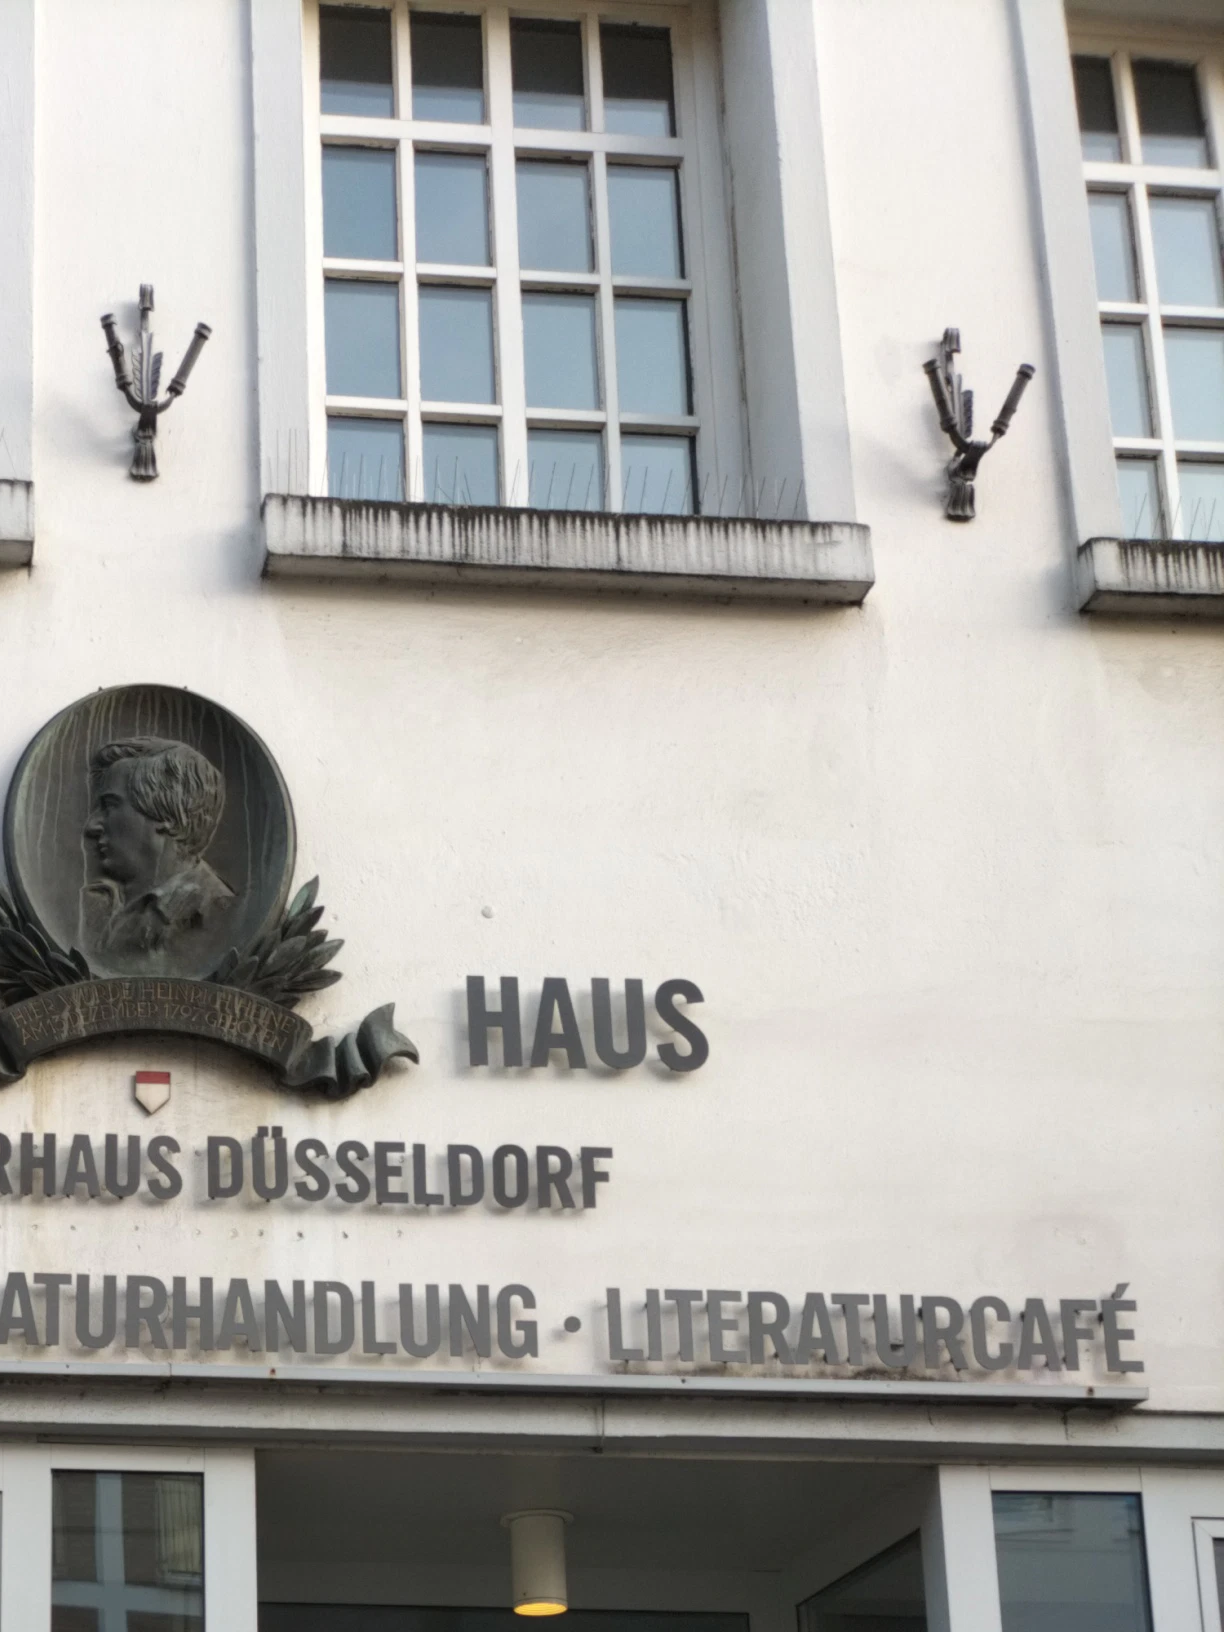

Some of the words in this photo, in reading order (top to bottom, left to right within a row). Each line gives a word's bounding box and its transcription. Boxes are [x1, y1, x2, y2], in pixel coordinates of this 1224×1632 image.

[464, 974, 710, 1073] HAUS
[207, 1126, 614, 1211] DÜSSELDORF
[605, 1282, 1146, 1375] LITERATURCAFÉ
